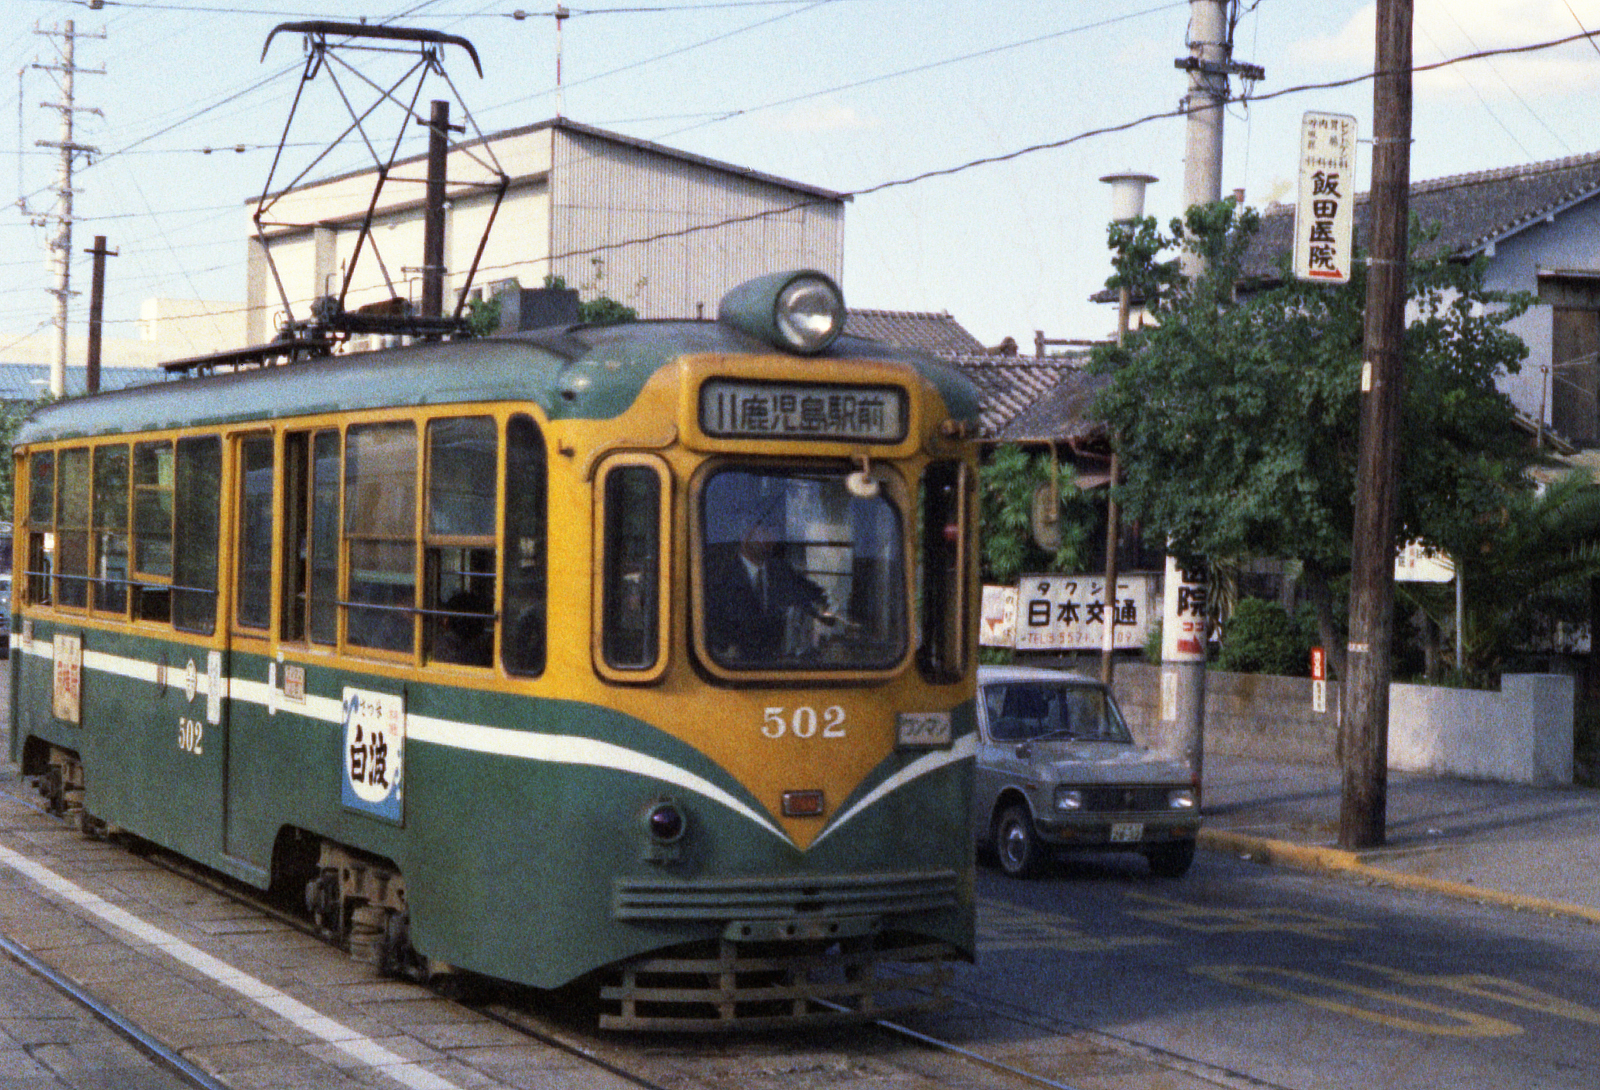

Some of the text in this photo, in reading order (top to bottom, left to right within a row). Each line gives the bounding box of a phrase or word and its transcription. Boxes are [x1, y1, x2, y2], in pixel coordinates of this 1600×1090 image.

[1308, 170, 1342, 270] 飯田医院
[1037, 581, 1129, 597] タクシー
[1028, 599, 1138, 628] 日本交通
[178, 717, 203, 755] 502
[760, 705, 847, 738] 502
[350, 724, 389, 790] 白波
